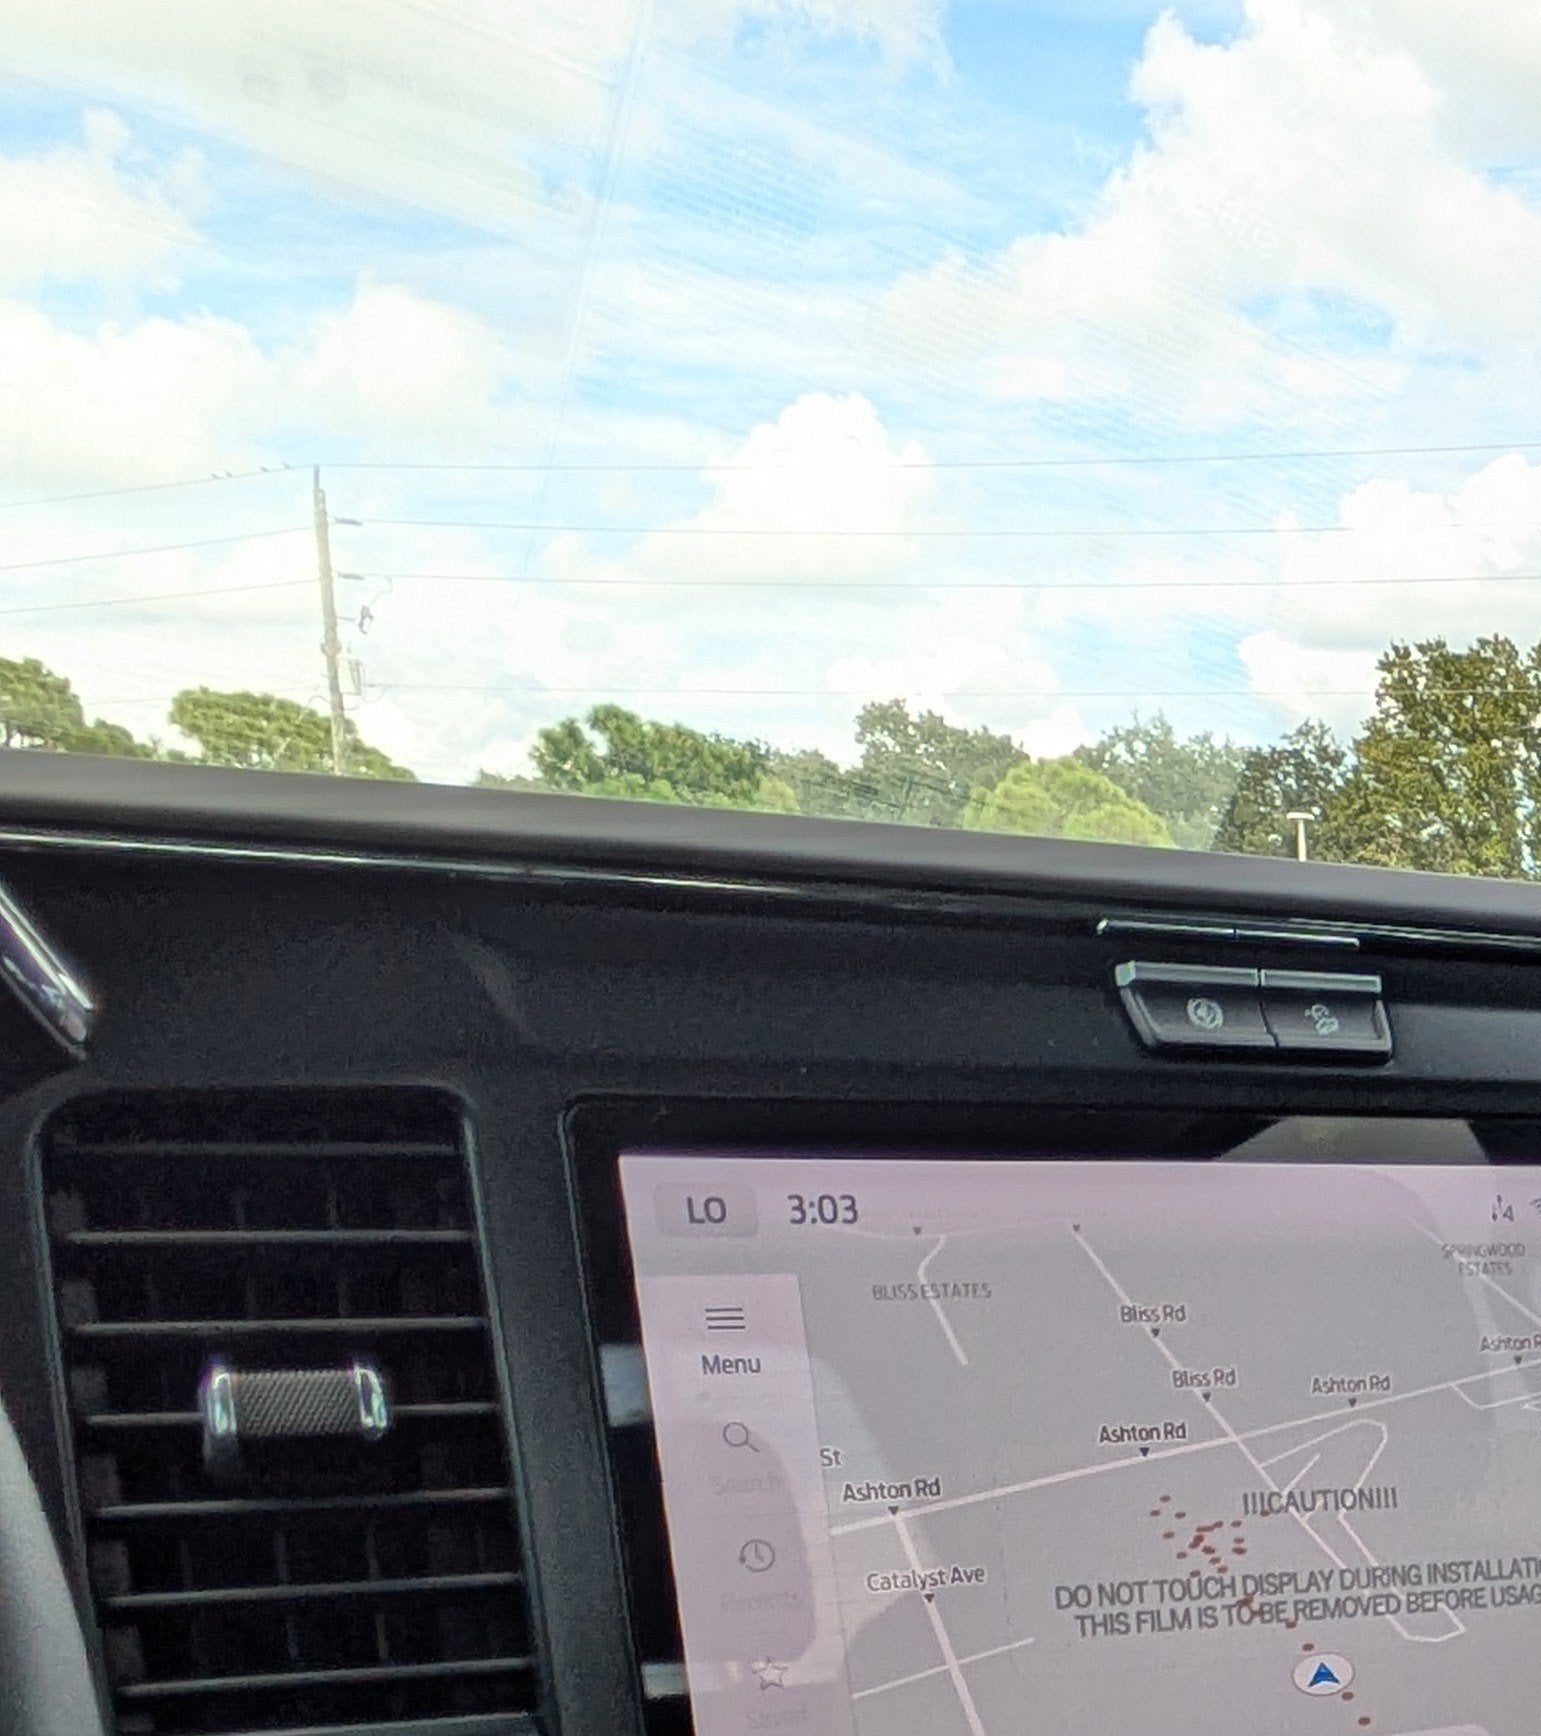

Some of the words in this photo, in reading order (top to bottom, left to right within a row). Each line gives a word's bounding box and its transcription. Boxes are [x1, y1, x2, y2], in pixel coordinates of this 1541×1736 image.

[687, 1197, 727, 1225] LO
[788, 1194, 858, 1225] 3:03
[872, 1283, 918, 1301] BLISS
[920, 1281, 993, 1299] ESTATES
[1120, 1305, 1159, 1323] Bliss
[1162, 1303, 1187, 1322] Rd
[1480, 1335, 1528, 1353] Ashton
[702, 1355, 761, 1376] Menu
[1173, 1370, 1211, 1388] Bliss
[1214, 1368, 1237, 1387] Rd
[1311, 1376, 1366, 1394] Ashton
[1368, 1374, 1391, 1391] Rd
[1099, 1423, 1161, 1443] Ashton
[1163, 1421, 1187, 1441] Rd
[819, 1449, 842, 1468] St
[843, 1480, 912, 1502] Ashton
[915, 1478, 941, 1498] Rd
[866, 1570, 947, 1593] Catalyst
[949, 1565, 986, 1585] Ave
[1055, 1586, 1092, 1610] DO
[1098, 1582, 1147, 1607] NOT
[1150, 1577, 1238, 1605] TOUCH
[1243, 1569, 1335, 1599] DISPLAY
[1339, 1565, 1423, 1591] DURING
[1075, 1613, 1130, 1639] THIS
[1136, 1608, 1192, 1635] FILM
[1197, 1606, 1218, 1630] IS
[1221, 1602, 1254, 1627] TO
[1256, 1600, 1288, 1626] BE
[1293, 1594, 1401, 1623] REMOVED
[1405, 1587, 1488, 1614] BEFORE
